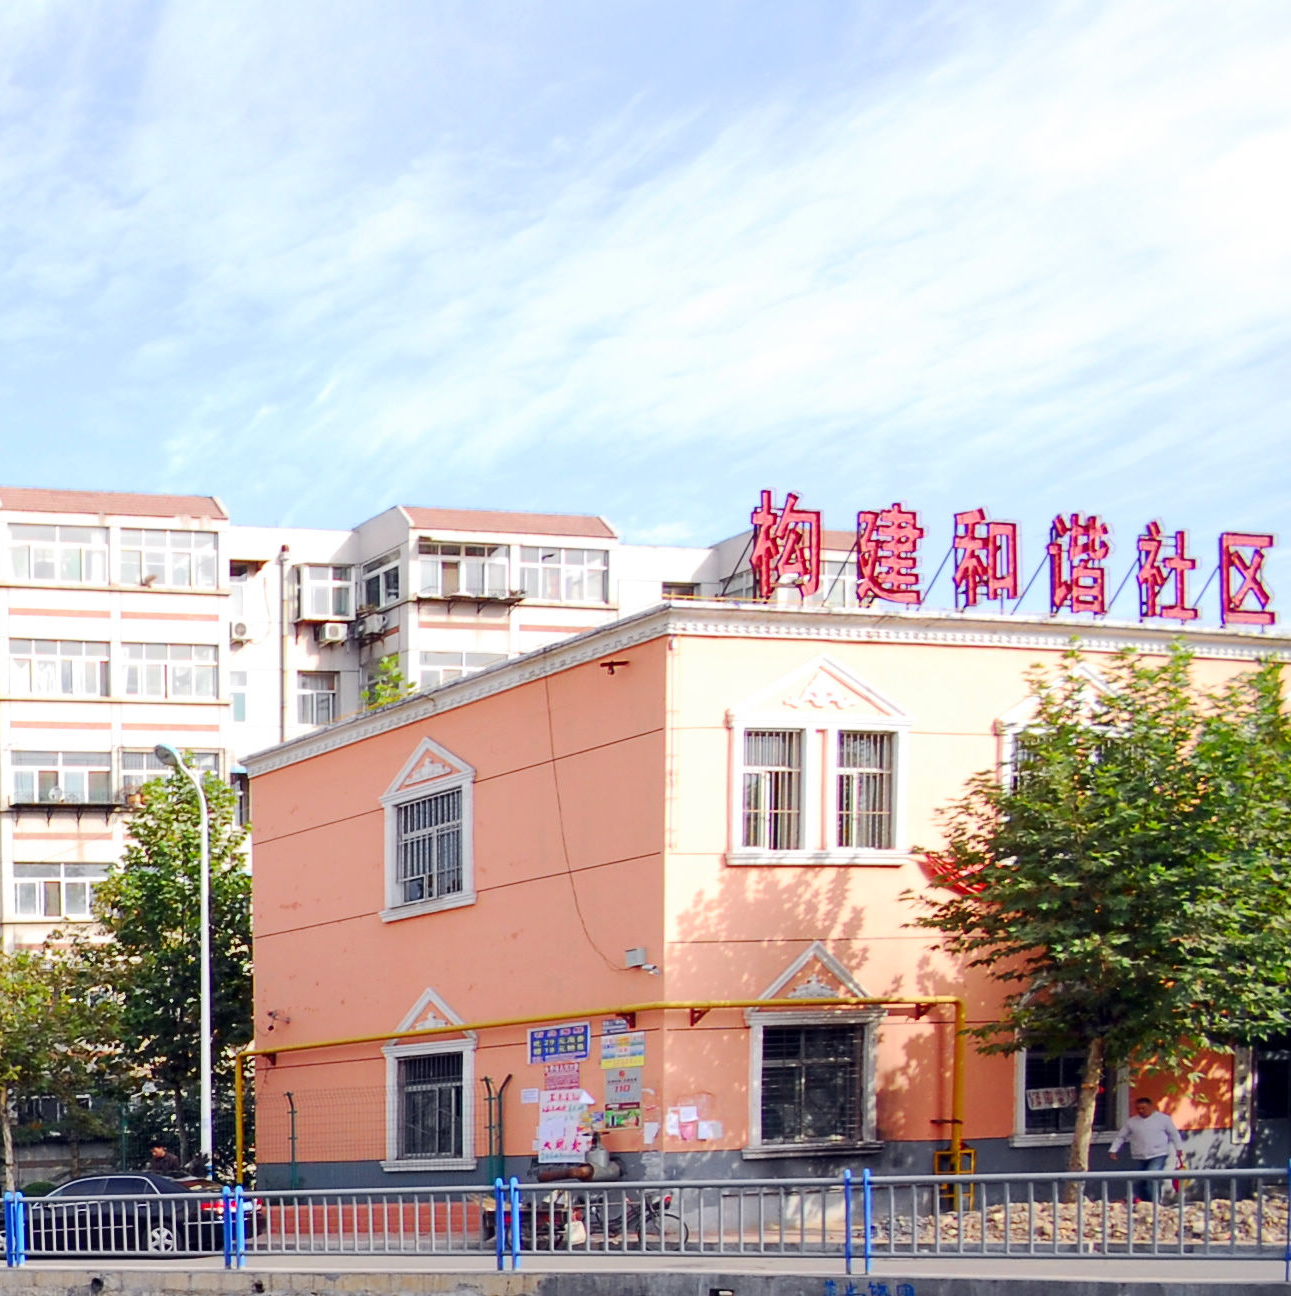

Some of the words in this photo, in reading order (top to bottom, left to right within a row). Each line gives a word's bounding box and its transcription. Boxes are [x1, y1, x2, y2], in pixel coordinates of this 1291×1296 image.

[750, 489, 1277, 626] 构建和谐社区
